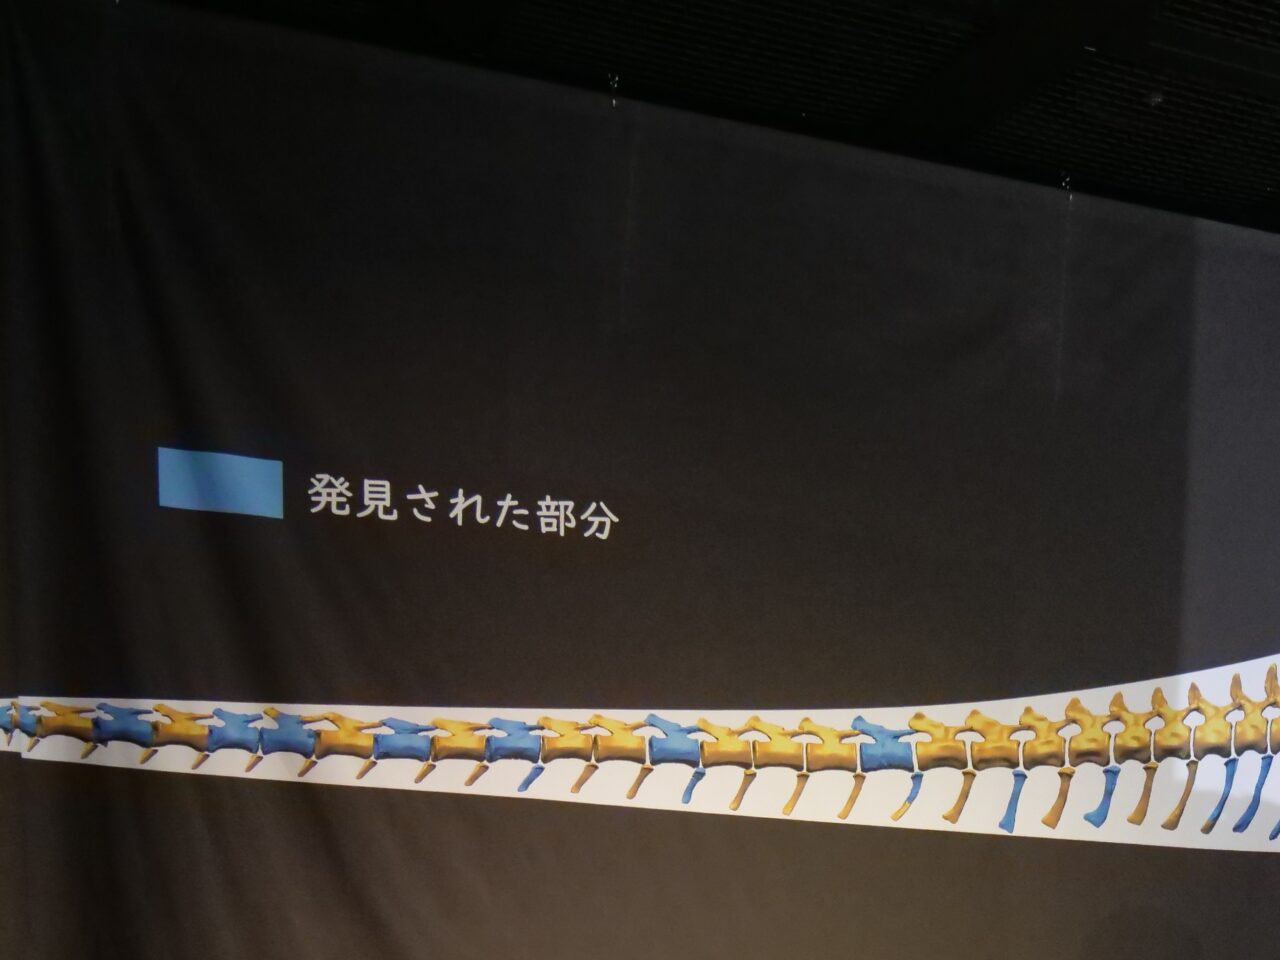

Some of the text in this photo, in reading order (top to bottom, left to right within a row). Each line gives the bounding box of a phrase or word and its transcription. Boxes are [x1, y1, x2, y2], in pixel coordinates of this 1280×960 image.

[308, 473, 619, 540] 発見された部分
